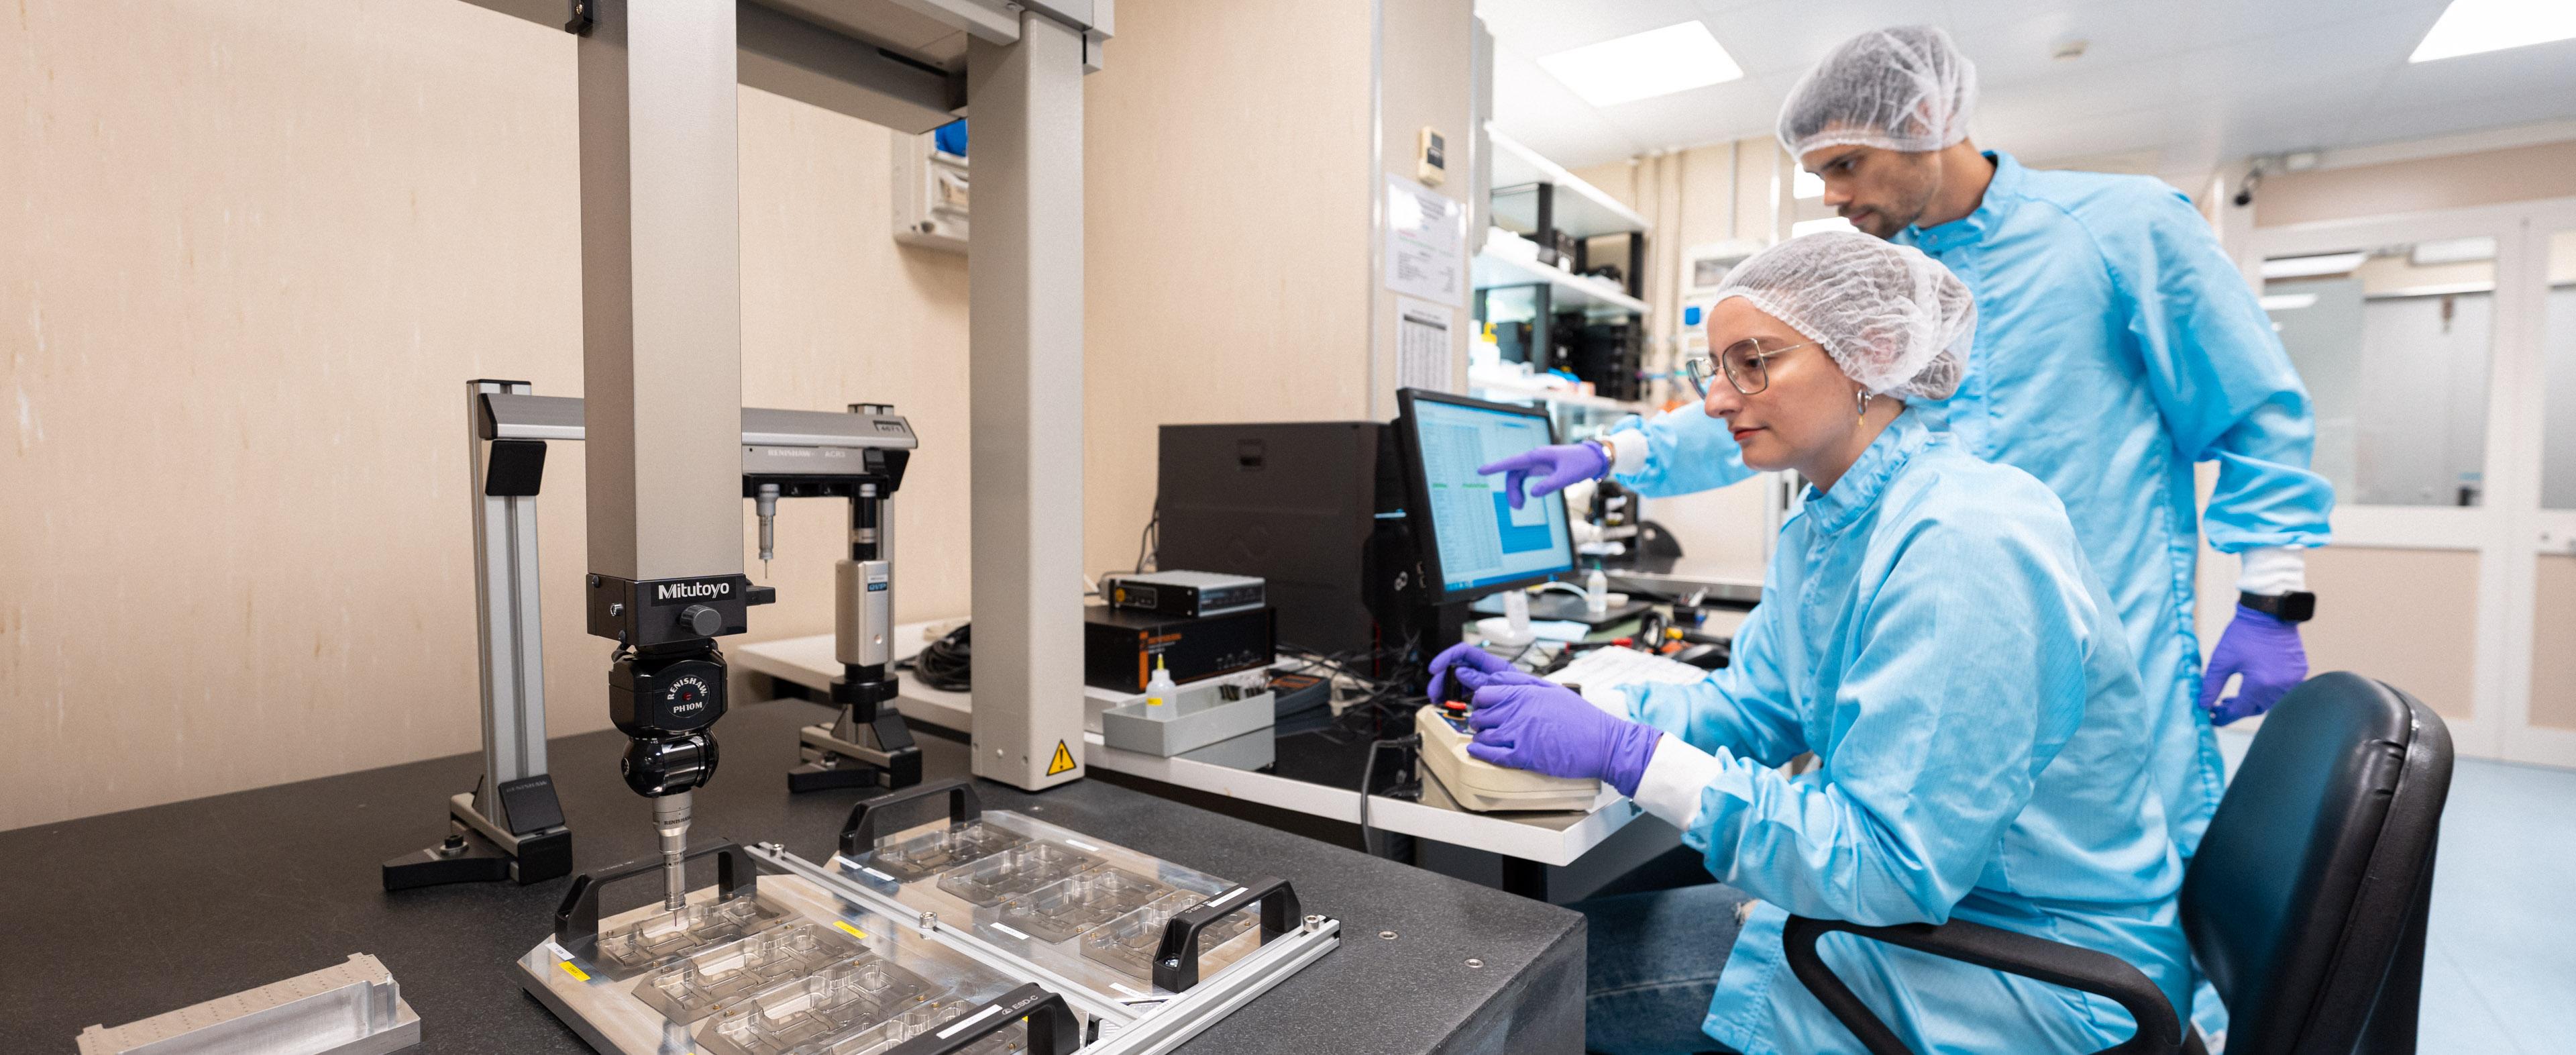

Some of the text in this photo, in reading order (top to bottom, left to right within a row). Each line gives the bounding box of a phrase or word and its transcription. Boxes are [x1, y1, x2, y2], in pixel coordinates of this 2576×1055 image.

[658, 582, 730, 600] Mitutoyo
[667, 676, 708, 701] RENISHAW
[673, 701, 703, 714] PH10M
[1012, 995, 1038, 1010] ESD-C
